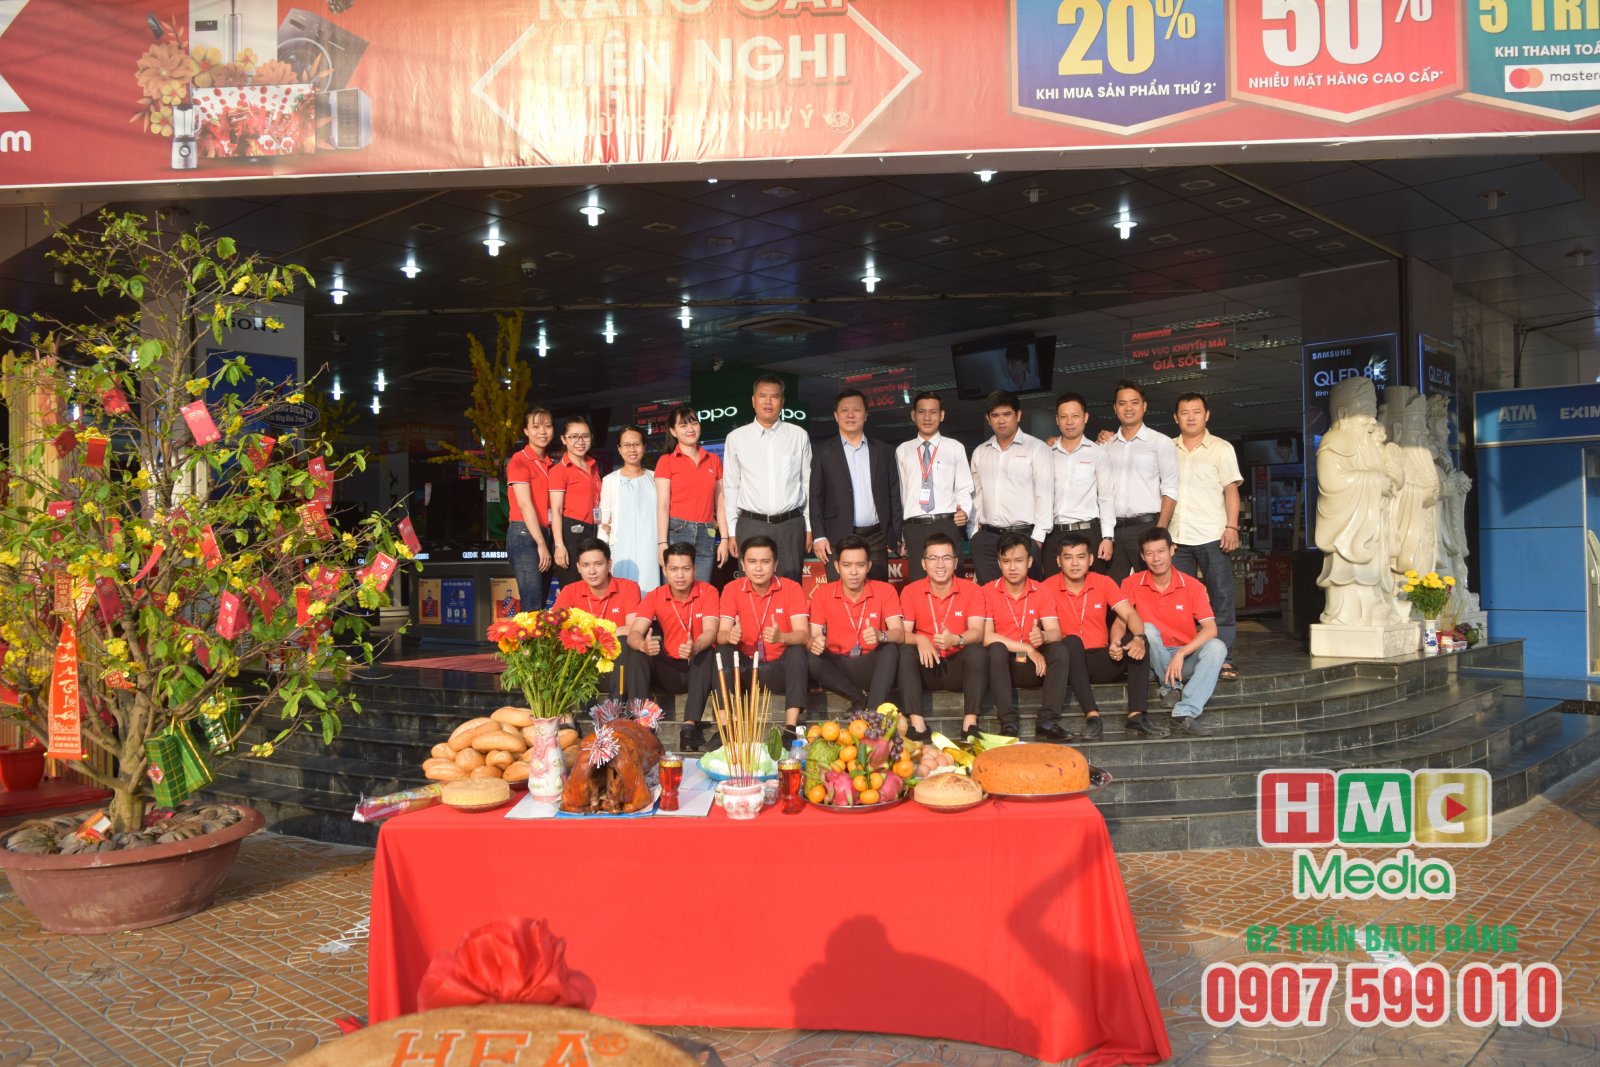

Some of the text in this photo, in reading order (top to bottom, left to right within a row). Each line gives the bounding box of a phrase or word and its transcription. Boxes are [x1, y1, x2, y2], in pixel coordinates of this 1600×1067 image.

[1057, 0, 1196, 75] 20%
[1495, 46, 1518, 58] KHI
[1522, 44, 1571, 57] THANH
[553, 29, 848, 100] TIỆN NGHI
[1248, 71, 1290, 88] NHIỀU
[1294, 75, 1323, 89] MẶT
[1327, 72, 1369, 86] HÀNG
[1373, 72, 1405, 84] CAO
[1036, 88, 1060, 100] KHI
[1064, 87, 1094, 99] MUA
[1098, 83, 1125, 97] SẢN
[1129, 79, 1170, 96] PHẨM
[1174, 80, 1201, 95] THỨ
[739, 108, 792, 131] NHƯ
[801, 104, 815, 129] Ý
[223, 317, 279, 333] SON
[1132, 337, 1226, 358] KHU VỰC KHUYẾN MÃI
[1312, 349, 1351, 360] SAMSUNG
[1153, 352, 1204, 370] GIÁ SỐC
[1428, 365, 1443, 384] QLED
[873, 382, 896, 394] KHUYẾN
[876, 393, 895, 406] SỐC
[697, 406, 738, 422] ppo
[779, 407, 807, 421] po
[1498, 404, 1537, 422] ATM
[56, 508, 67, 516] NK
[380, 560, 390, 570] NK
[888, 563, 903, 577] NK
[325, 571, 335, 579] NK
[225, 601, 233, 611] NK
